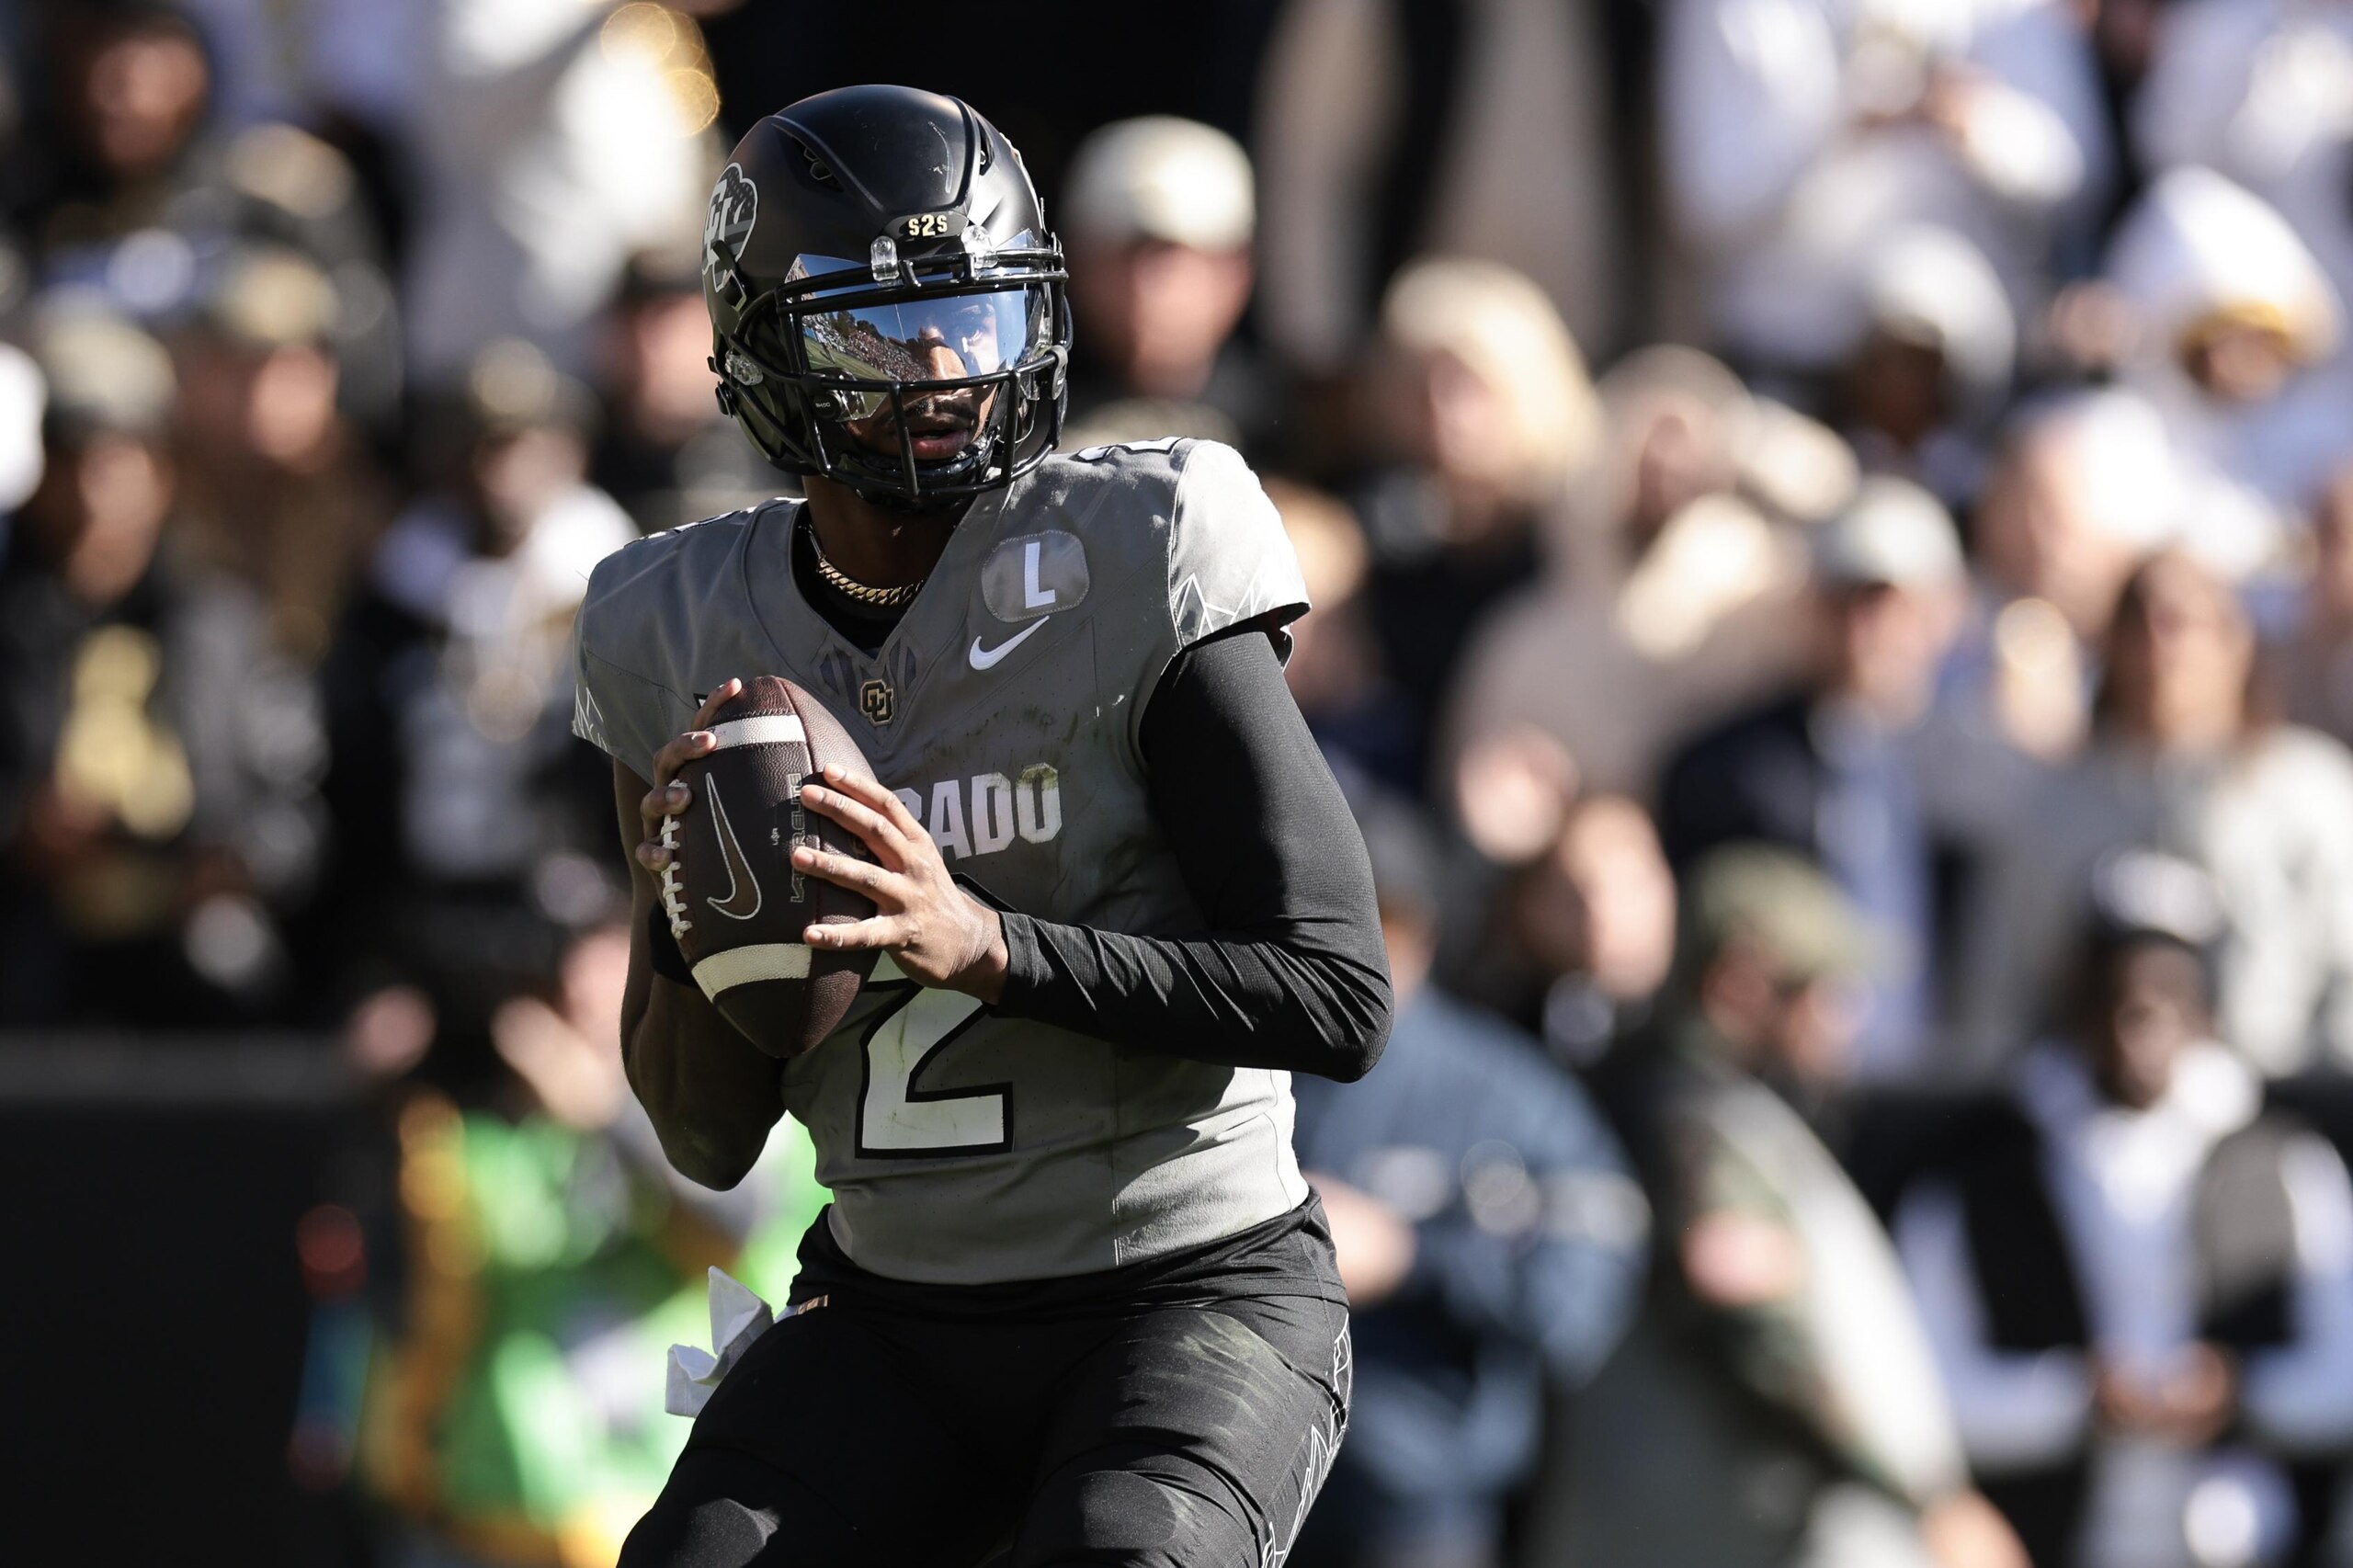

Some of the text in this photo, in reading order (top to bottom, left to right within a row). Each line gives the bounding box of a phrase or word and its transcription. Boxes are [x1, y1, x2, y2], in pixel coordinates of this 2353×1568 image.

[908, 214, 948, 236] S2S
[1025, 541, 1056, 609] L
[860, 679, 894, 726] CU
[790, 829, 807, 903] VAR
[855, 873, 1015, 1160] 2
